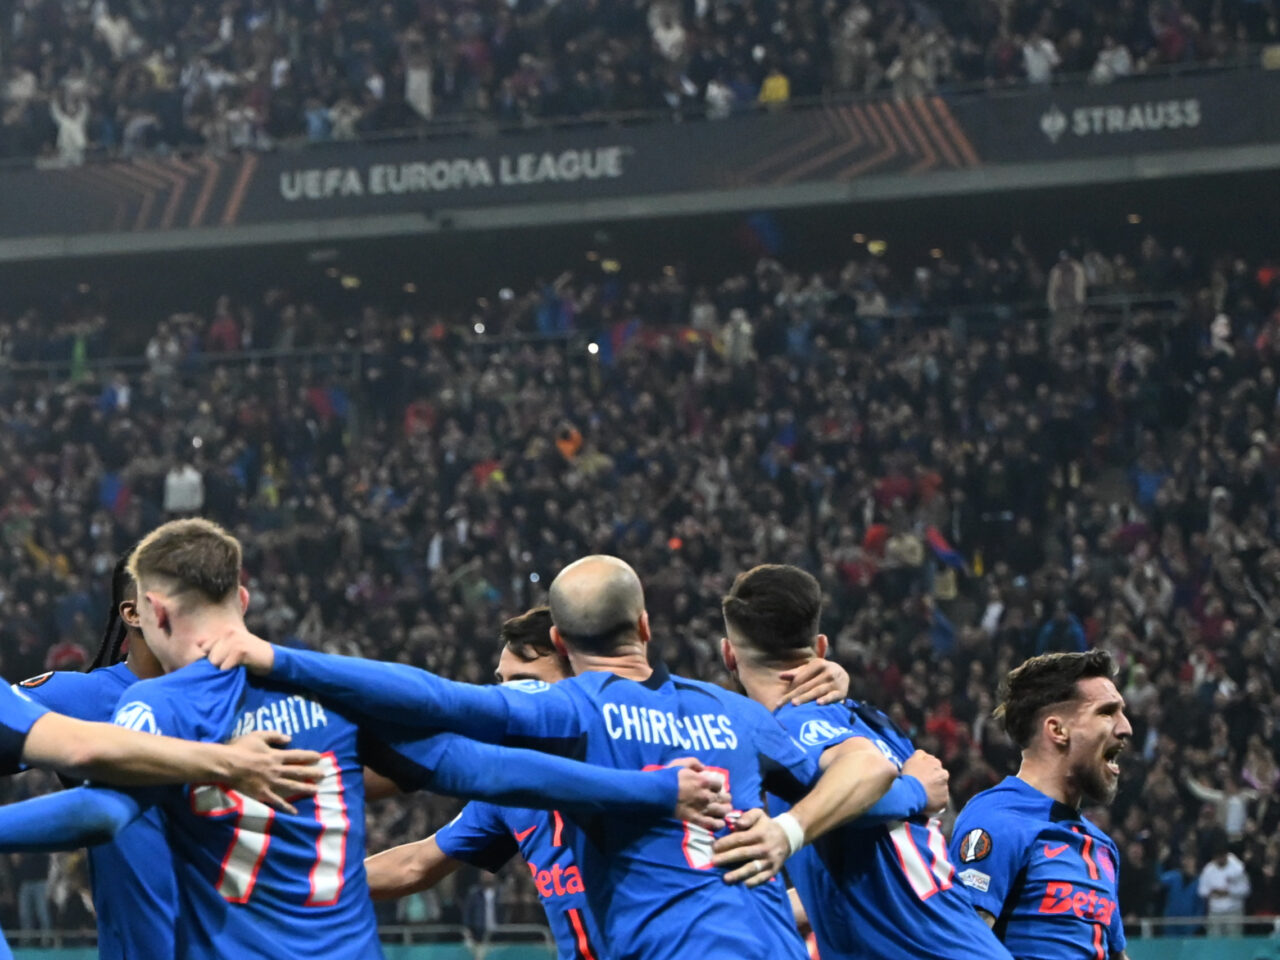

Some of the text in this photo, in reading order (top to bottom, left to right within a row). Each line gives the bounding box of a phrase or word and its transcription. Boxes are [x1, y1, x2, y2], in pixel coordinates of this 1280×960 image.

[1073, 98, 1202, 136] STRAUSS
[280, 146, 623, 200] UEFA EUROPA LEAGUE
[527, 862, 586, 898] eta
